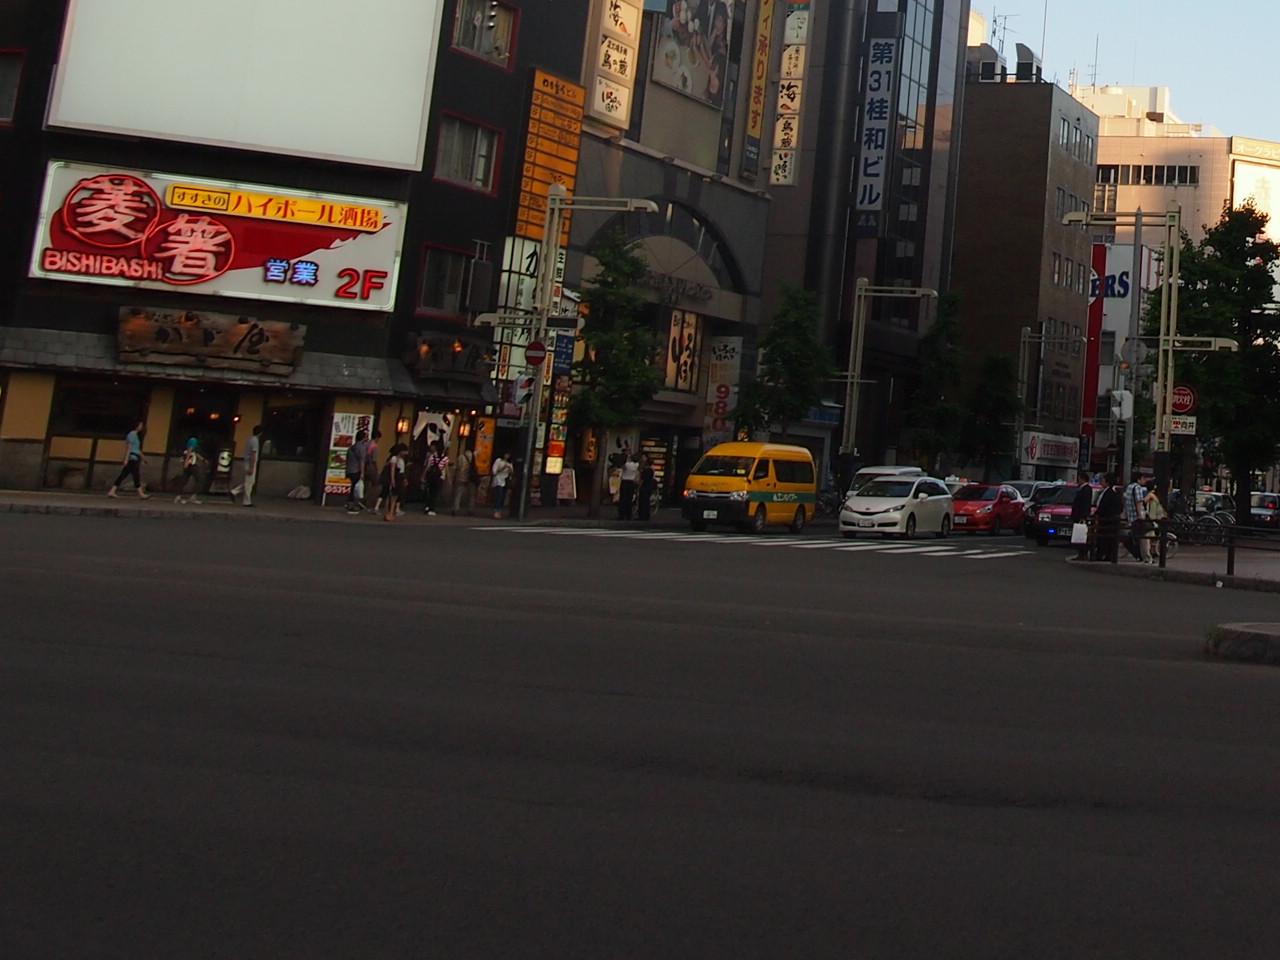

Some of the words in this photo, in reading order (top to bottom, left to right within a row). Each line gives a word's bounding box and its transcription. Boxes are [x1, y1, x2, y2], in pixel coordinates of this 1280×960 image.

[860, 41, 895, 206] 第31桂和ビル
[231, 195, 383, 229] ハイボール酒場
[43, 250, 163, 280] BISHIBASHI
[265, 258, 319, 286] 営業
[334, 268, 388, 300] 2F
